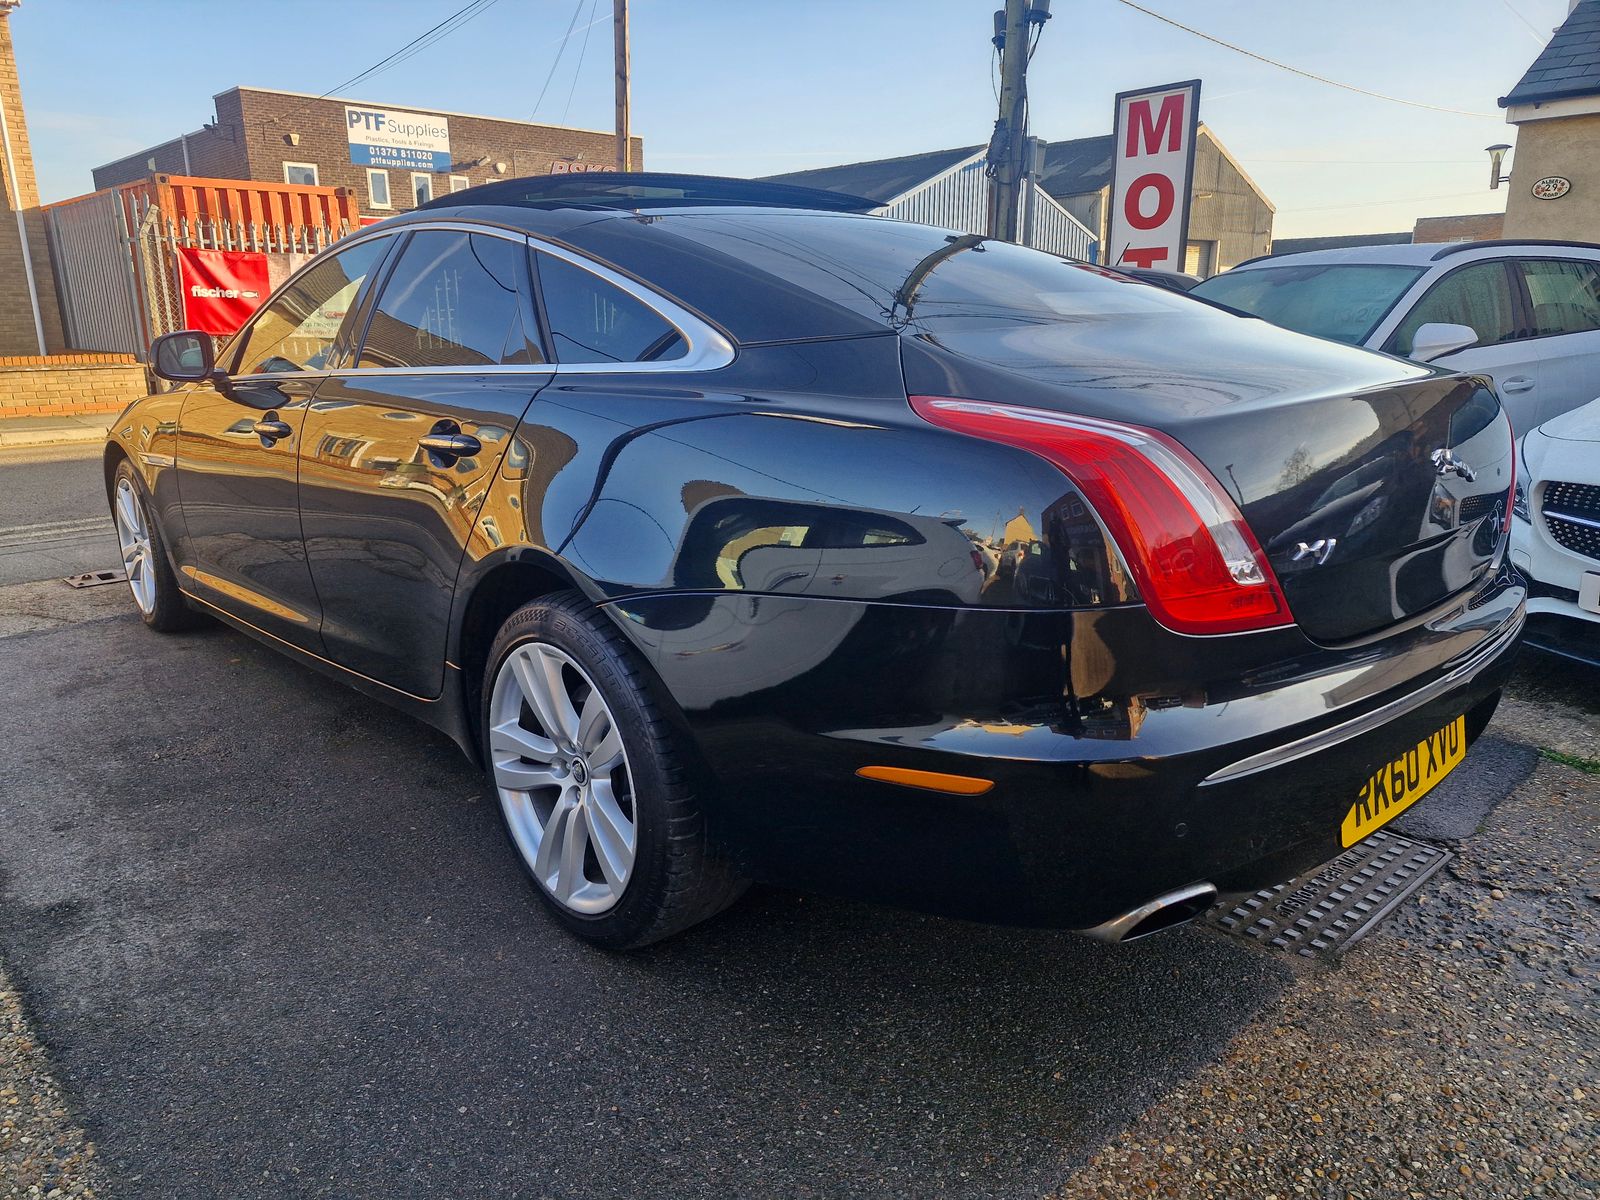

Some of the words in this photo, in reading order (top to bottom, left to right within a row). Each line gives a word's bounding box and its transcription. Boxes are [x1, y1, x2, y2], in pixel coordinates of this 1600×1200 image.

[348, 110, 385, 131] PTF
[388, 119, 447, 138] Supplies
[369, 146, 398, 157] 01376
[400, 149, 433, 160] 811020
[370, 157, 434, 169] ptfsupplies.com
[1545, 183, 1557, 191] 29
[191, 285, 239, 299] fischer
[1355, 745, 1420, 828] RK60
[1284, 884, 1320, 908] SONS
